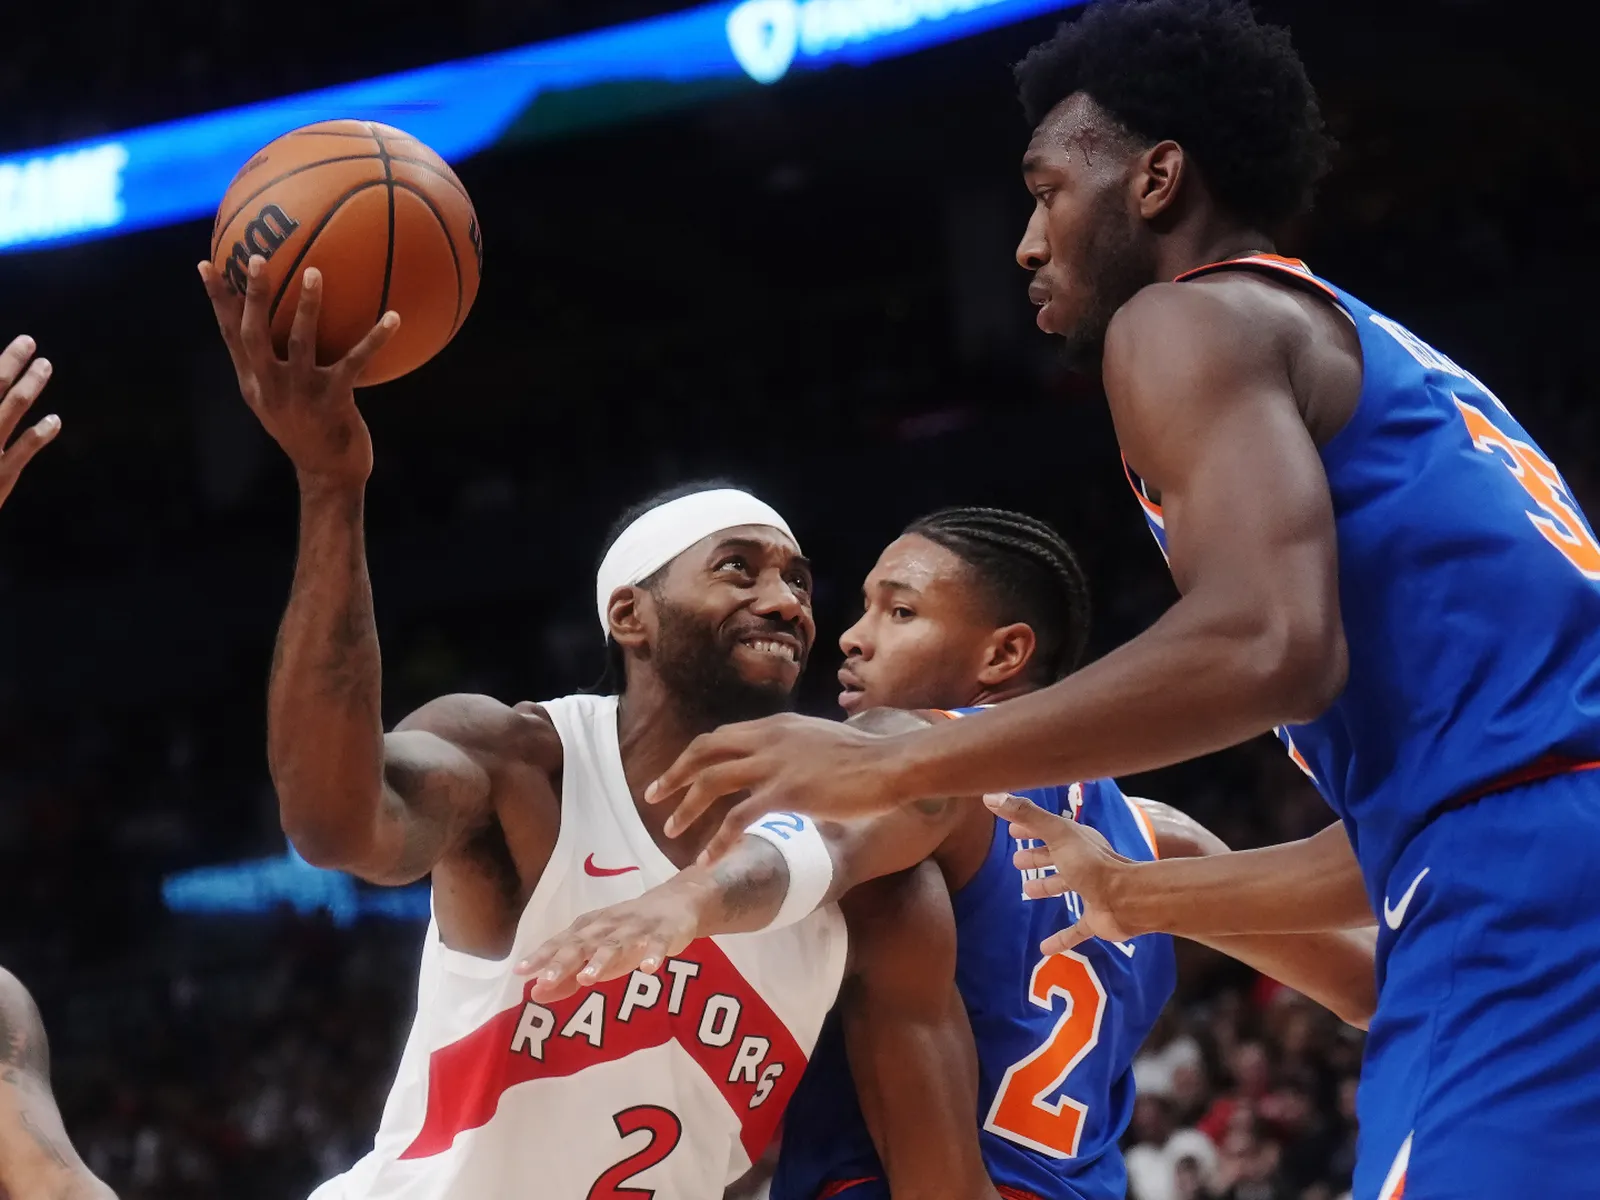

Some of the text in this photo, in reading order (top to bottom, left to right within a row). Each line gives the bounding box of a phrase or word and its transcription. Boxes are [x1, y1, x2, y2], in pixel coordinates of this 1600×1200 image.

[509, 957, 783, 1110] RAPTORS
[982, 949, 1108, 1159] 2
[586, 1104, 682, 1200] 2
